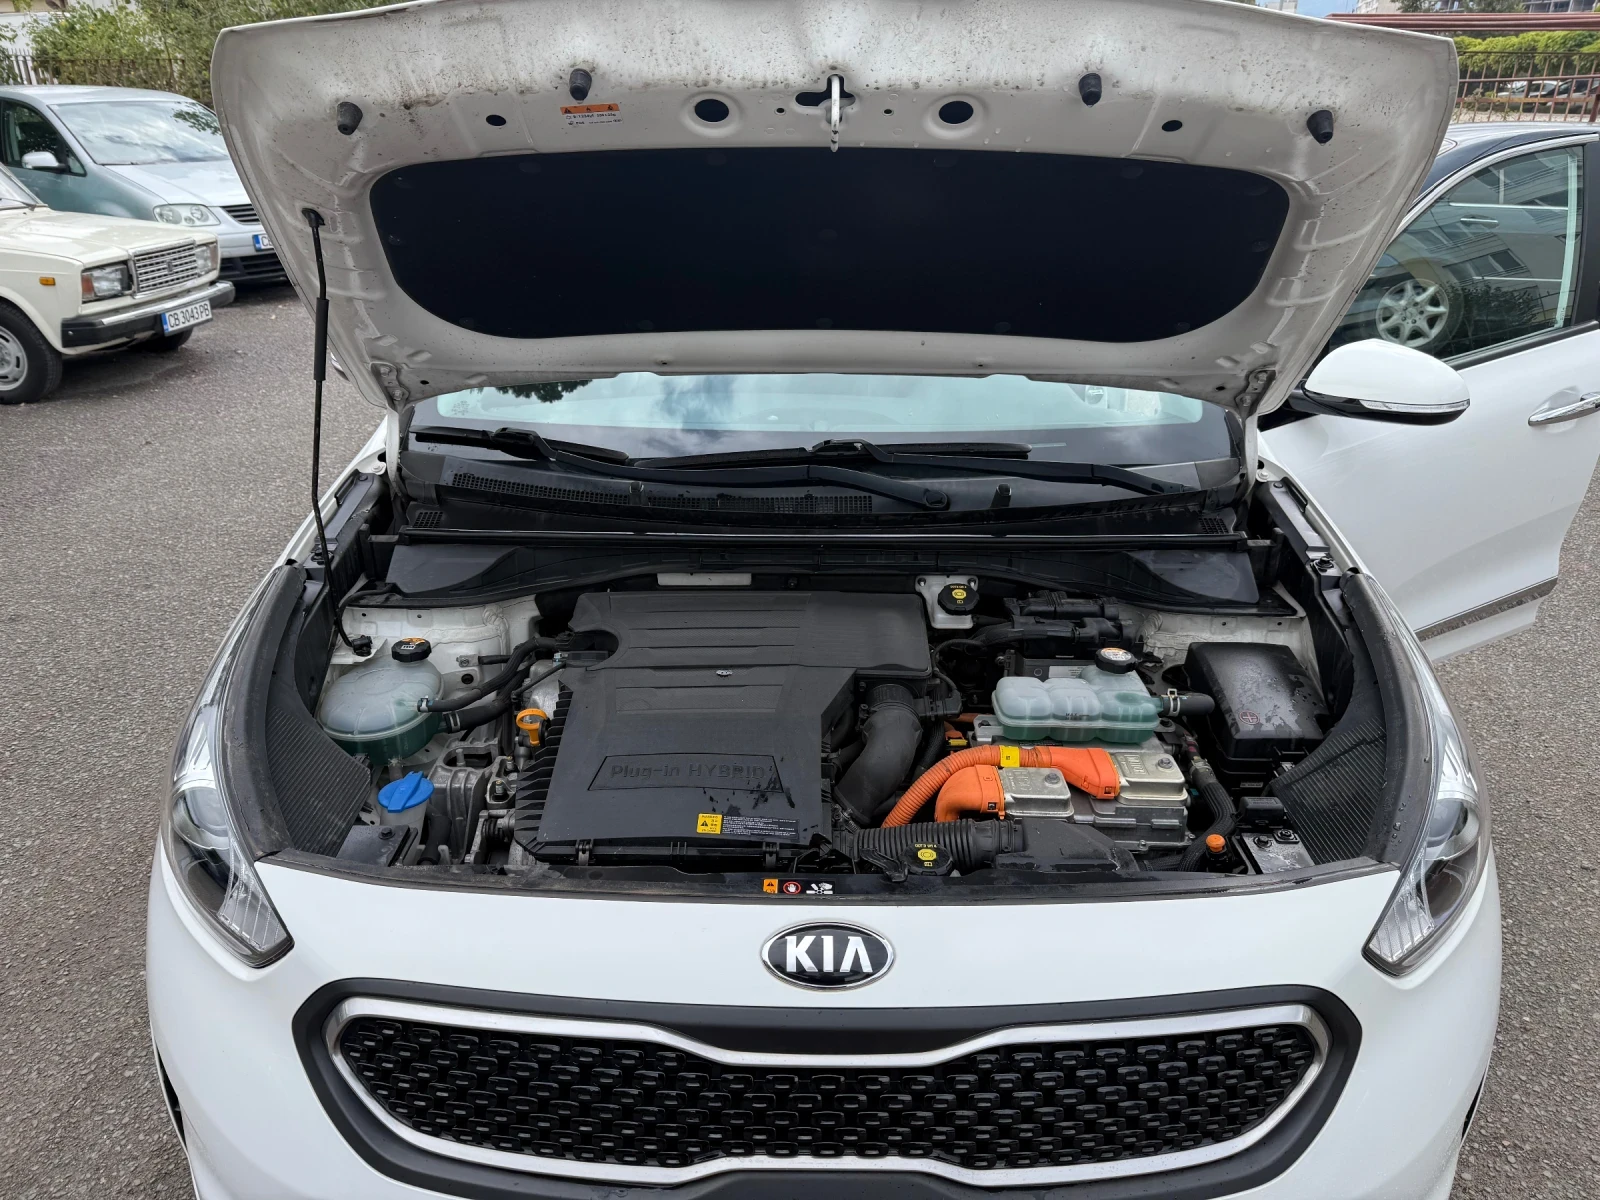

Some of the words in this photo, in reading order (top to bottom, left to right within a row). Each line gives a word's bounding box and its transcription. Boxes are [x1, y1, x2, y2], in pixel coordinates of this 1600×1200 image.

[168, 312, 180, 328] CB
[180, 306, 199, 325] 3043
[610, 763, 680, 779] Plug-in
[688, 763, 766, 780] HYBRID
[784, 935, 873, 973] KIA
